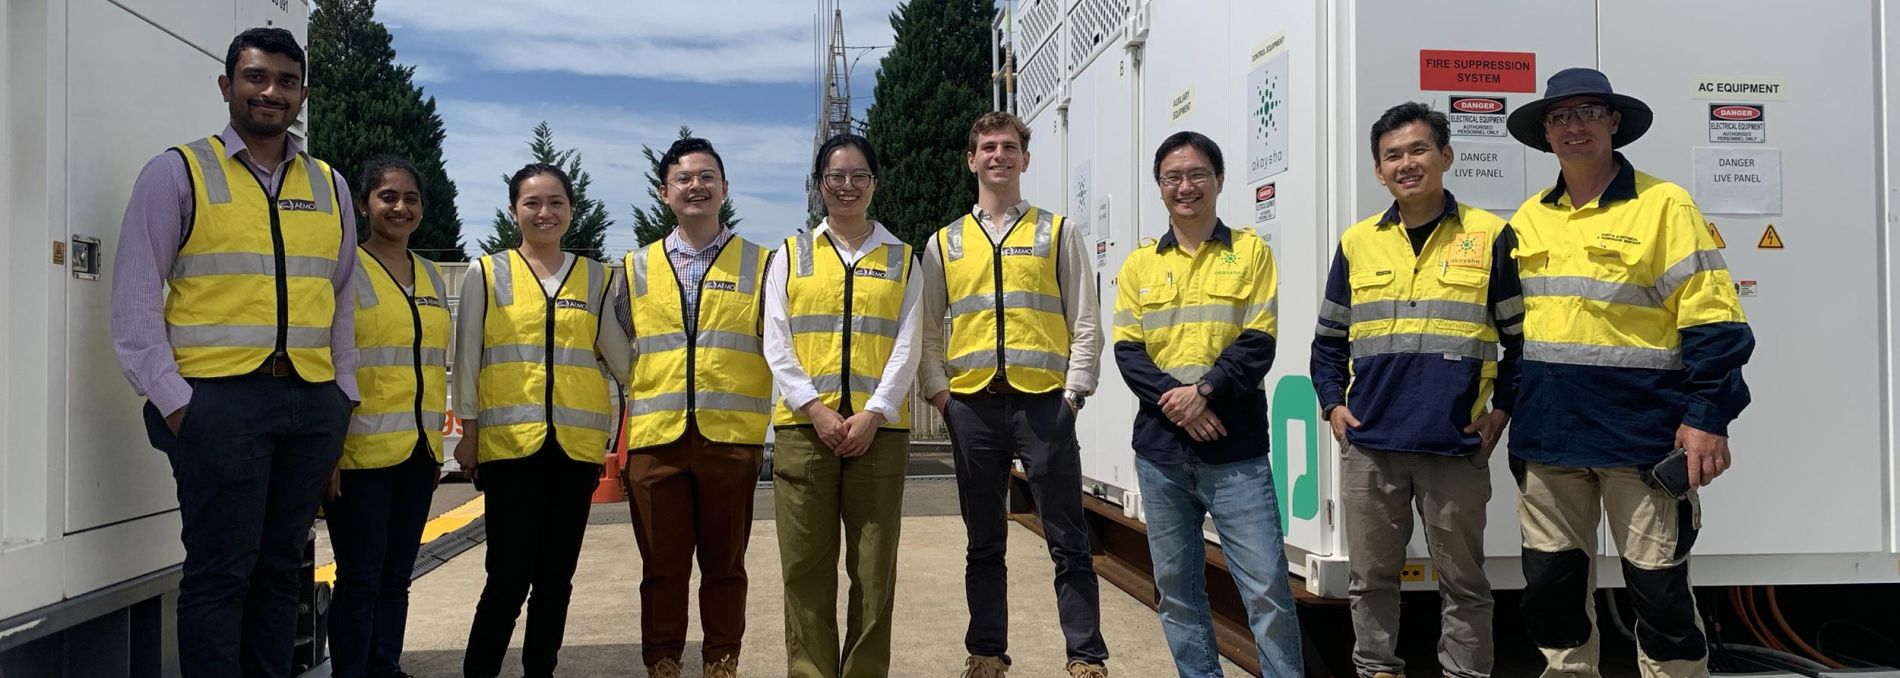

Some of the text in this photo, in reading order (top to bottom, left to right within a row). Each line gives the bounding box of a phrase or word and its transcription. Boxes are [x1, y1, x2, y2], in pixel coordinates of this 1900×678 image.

[1266, 36, 1284, 53] EQUIPMENT
[1426, 59, 1530, 70] FIRE SUPPRESSION
[1457, 73, 1501, 83] SYSTEM
[1698, 83, 1780, 93] AC EQUIPMENT
[1451, 115, 1479, 123] ELECTRICAL
[1711, 122, 1737, 130] ELECTRICAL
[1460, 152, 1498, 162] DANGER
[1719, 158, 1755, 167] DANGER
[1455, 168, 1504, 178] LIVE PANEL
[1714, 174, 1761, 183] LIVE PANEL
[295, 202, 315, 210] AEMO
[867, 269, 887, 278] AEMO
[717, 282, 736, 291] AEMO
